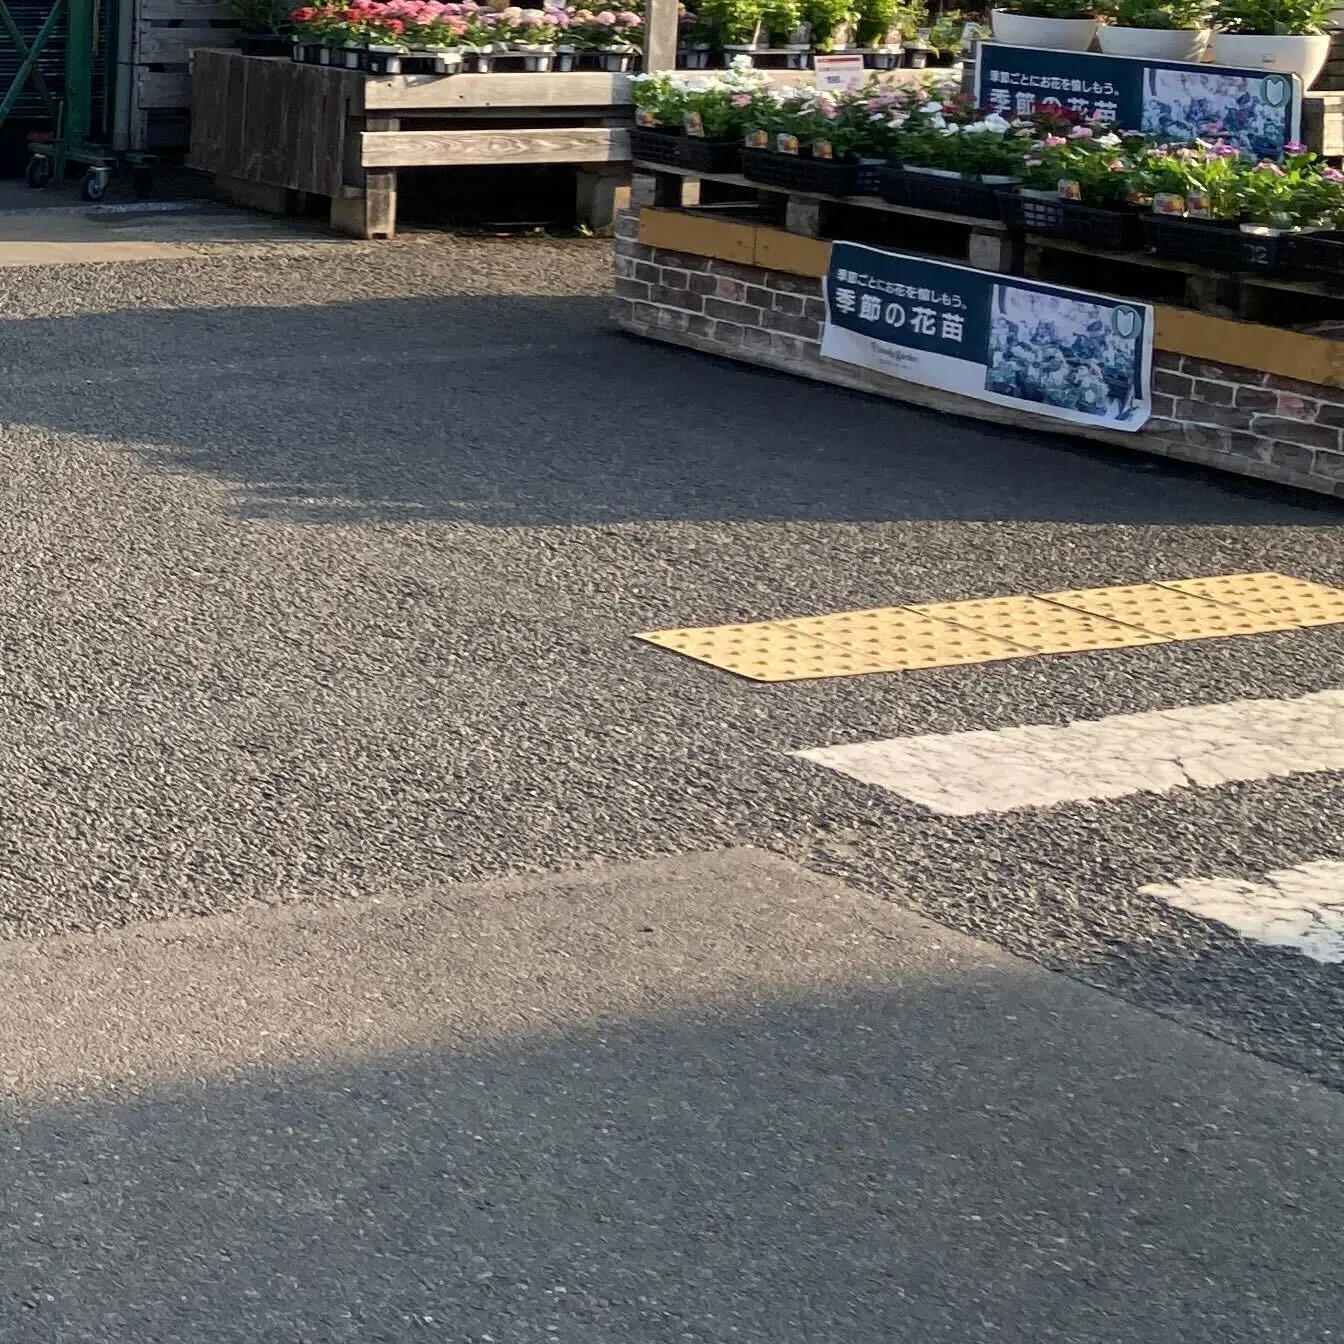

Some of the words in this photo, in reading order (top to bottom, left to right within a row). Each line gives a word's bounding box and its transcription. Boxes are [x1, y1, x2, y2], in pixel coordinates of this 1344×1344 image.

[835, 287, 965, 343] 季節の花苗
